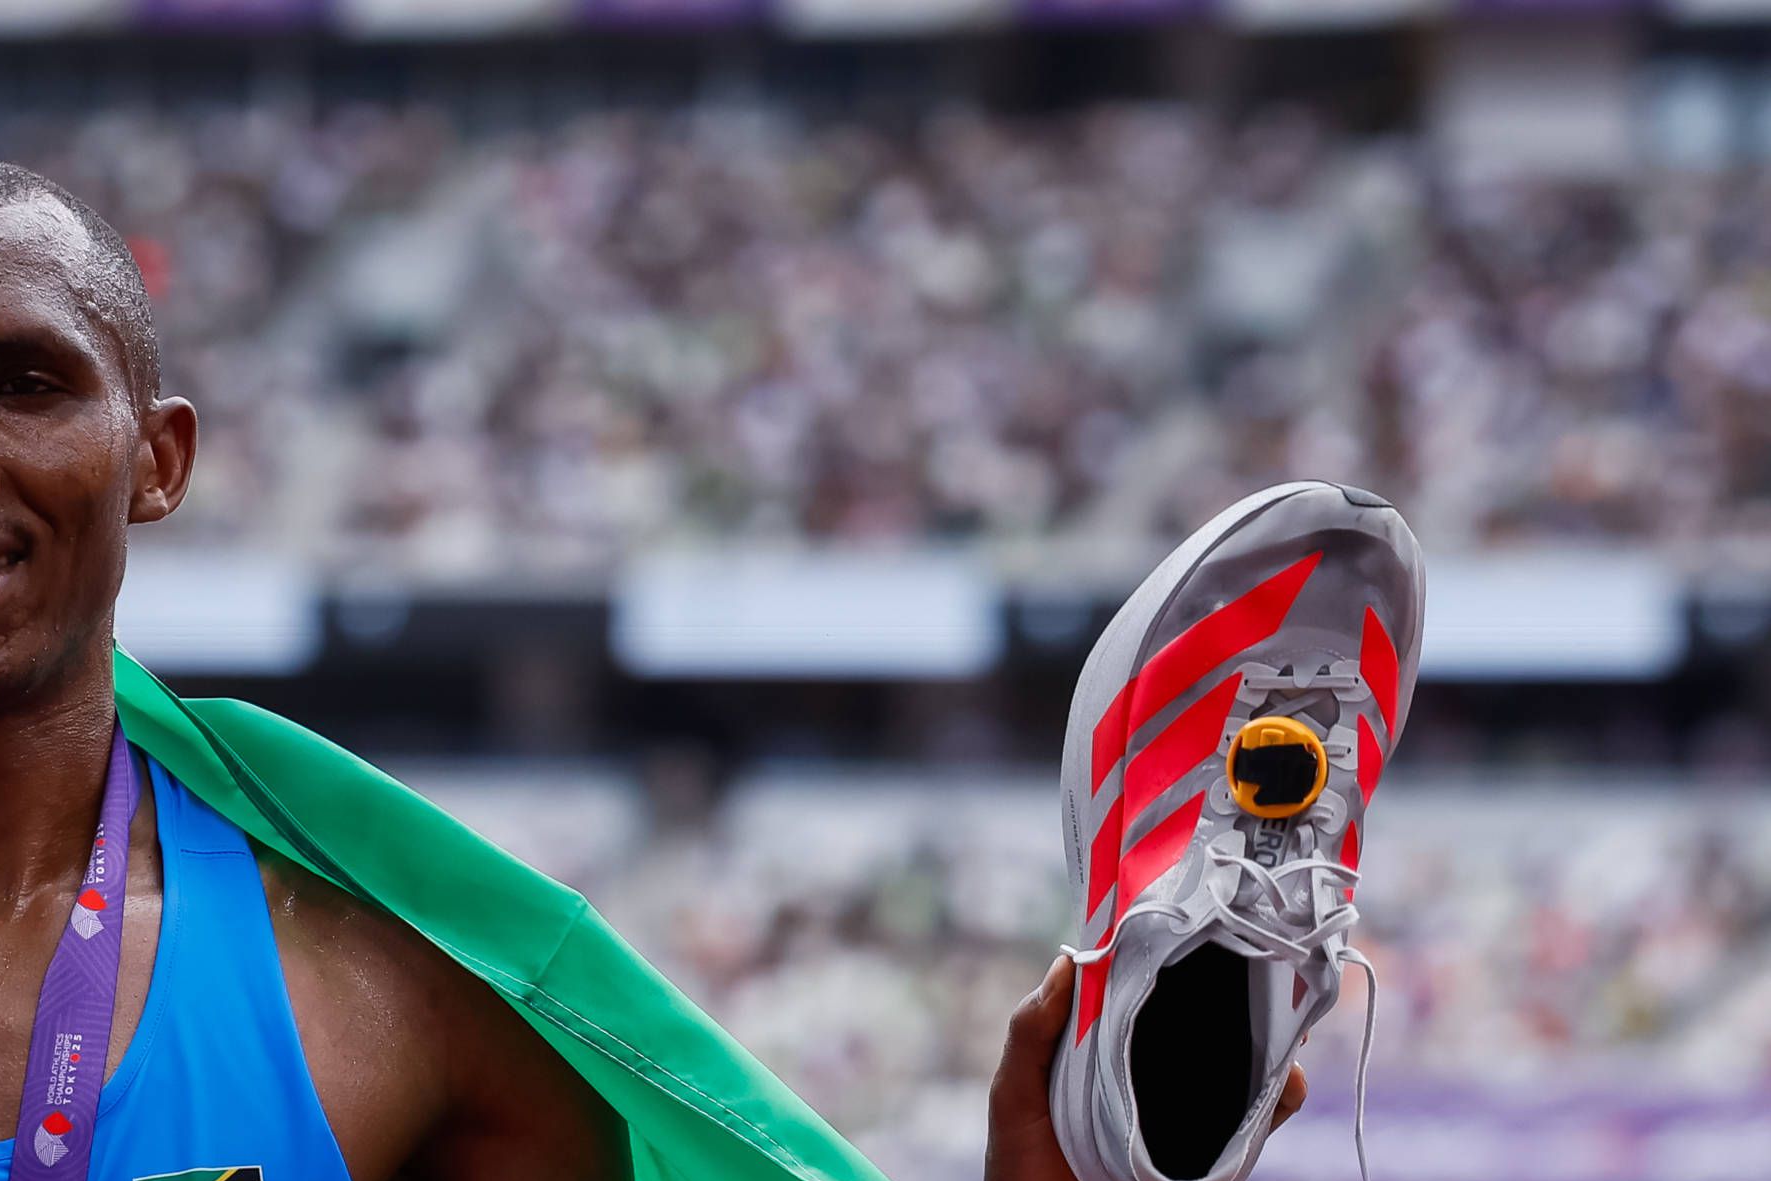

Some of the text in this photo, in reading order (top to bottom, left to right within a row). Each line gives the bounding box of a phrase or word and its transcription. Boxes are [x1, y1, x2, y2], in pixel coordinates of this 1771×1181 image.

[45, 1033, 64, 1104] WORLD ATHLETICS
[54, 1033, 73, 1105] CHAMPIONSHIPS
